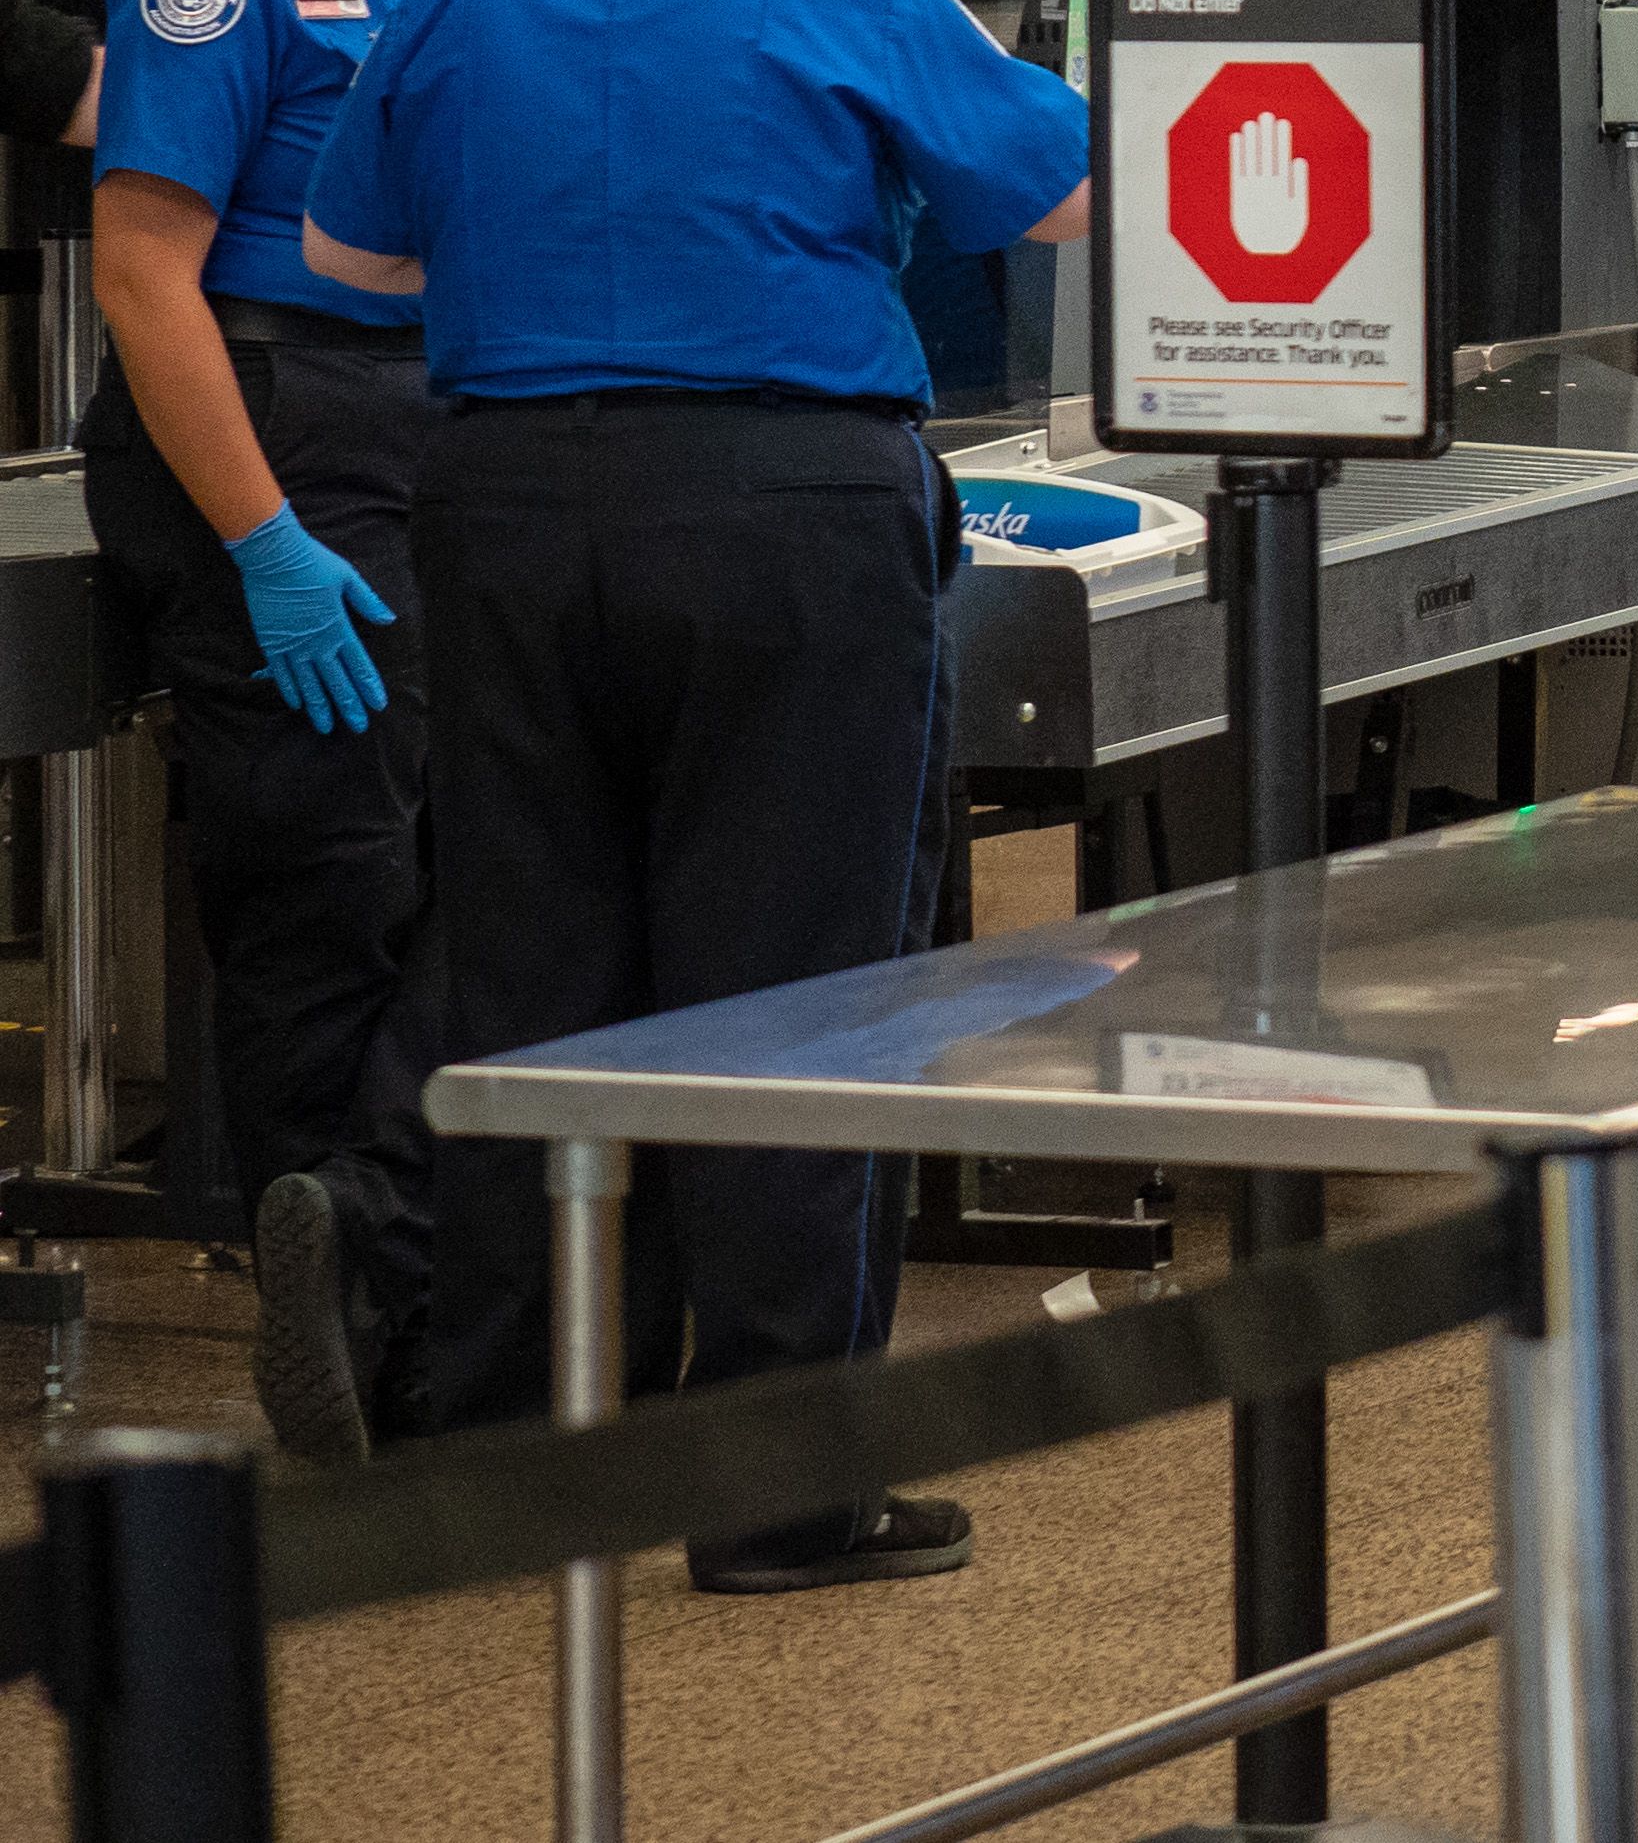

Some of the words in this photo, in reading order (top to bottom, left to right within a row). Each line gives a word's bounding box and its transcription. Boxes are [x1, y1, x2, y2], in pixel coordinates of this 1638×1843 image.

[1149, 316, 1208, 337] Please
[1213, 320, 1245, 337] see
[1249, 318, 1324, 342] Security
[1328, 319, 1391, 340] Officer
[1154, 341, 1180, 362] for
[1185, 344, 1281, 364] assistance.
[1286, 344, 1343, 365] Thank
[1349, 349, 1389, 368] you.
